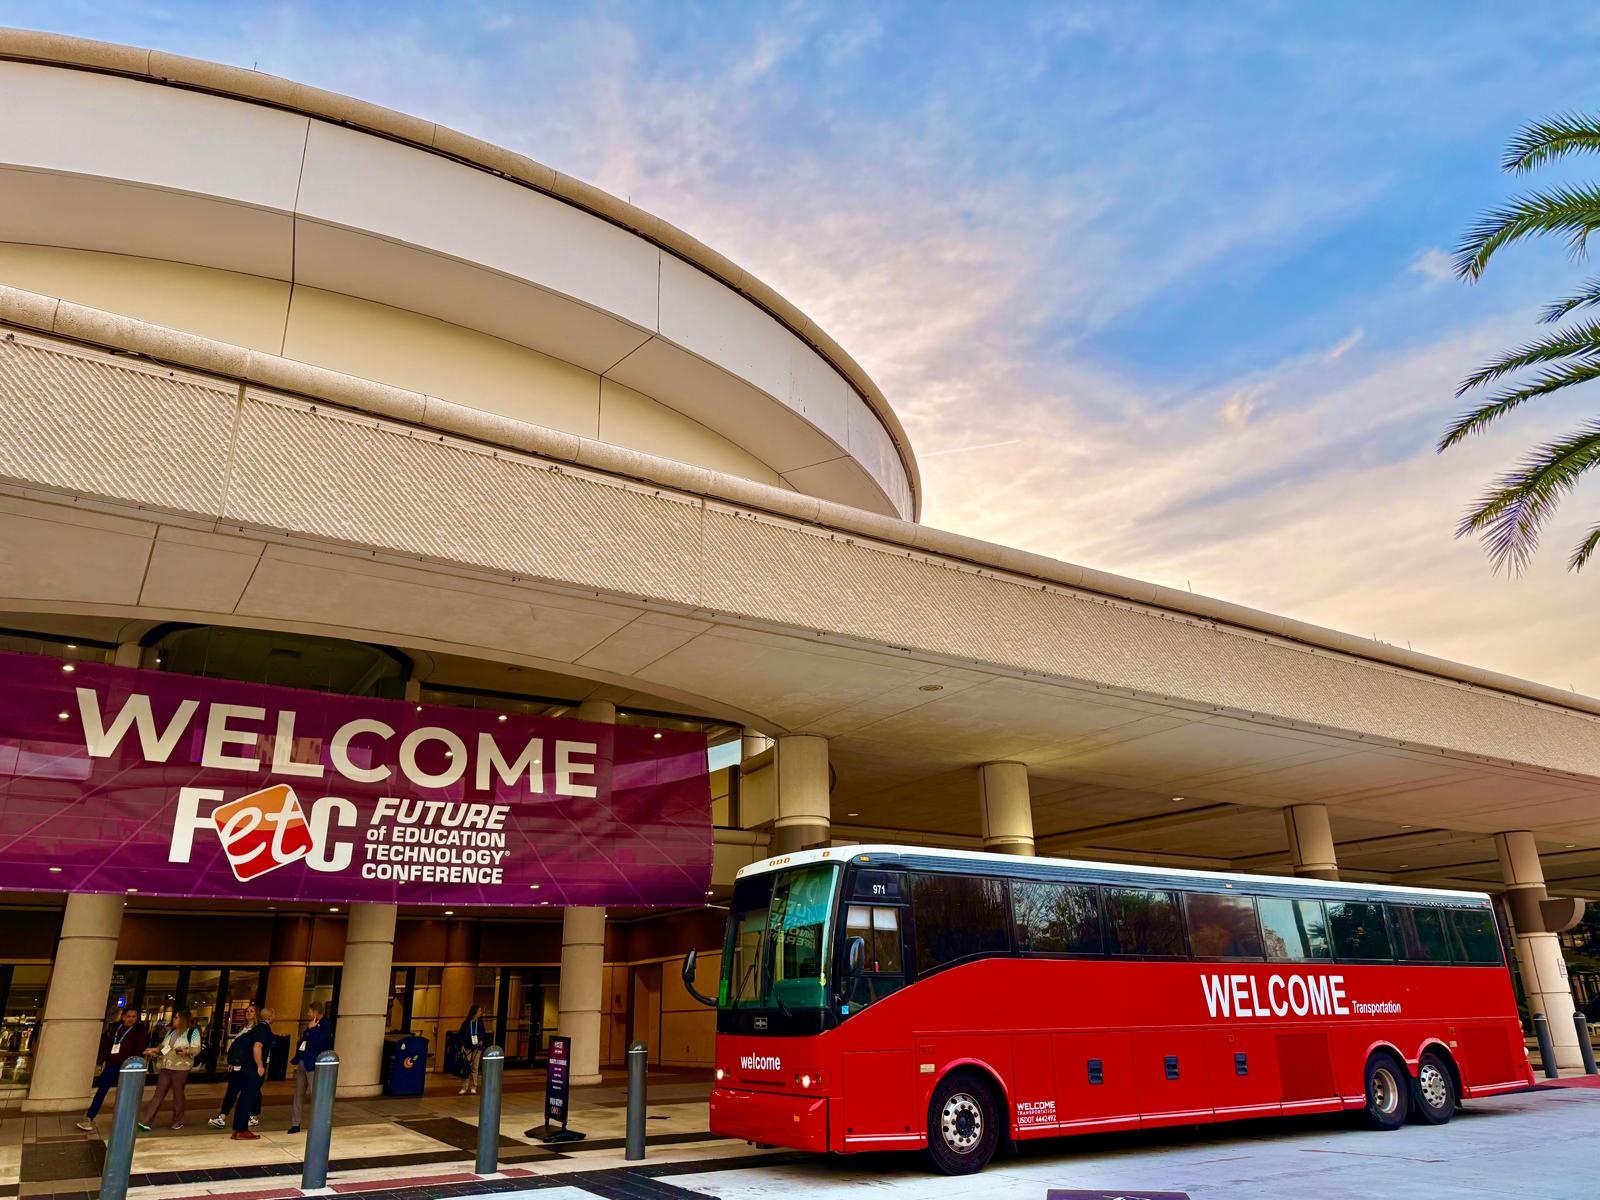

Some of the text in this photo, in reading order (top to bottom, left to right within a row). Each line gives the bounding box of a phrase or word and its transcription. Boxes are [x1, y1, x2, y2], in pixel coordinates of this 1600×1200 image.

[75, 687, 597, 798] WELCOME
[370, 797, 510, 830] FUTURE
[366, 826, 506, 848] of EDUCATION
[362, 863, 503, 885] CONFERENCE
[872, 884, 886, 895] 971
[1200, 974, 1401, 1018] WELCOME Transportation
[740, 1052, 781, 1070] welcome
[1016, 1101, 1056, 1111] WELCOME
[1017, 1116, 1034, 1124] USDOT
